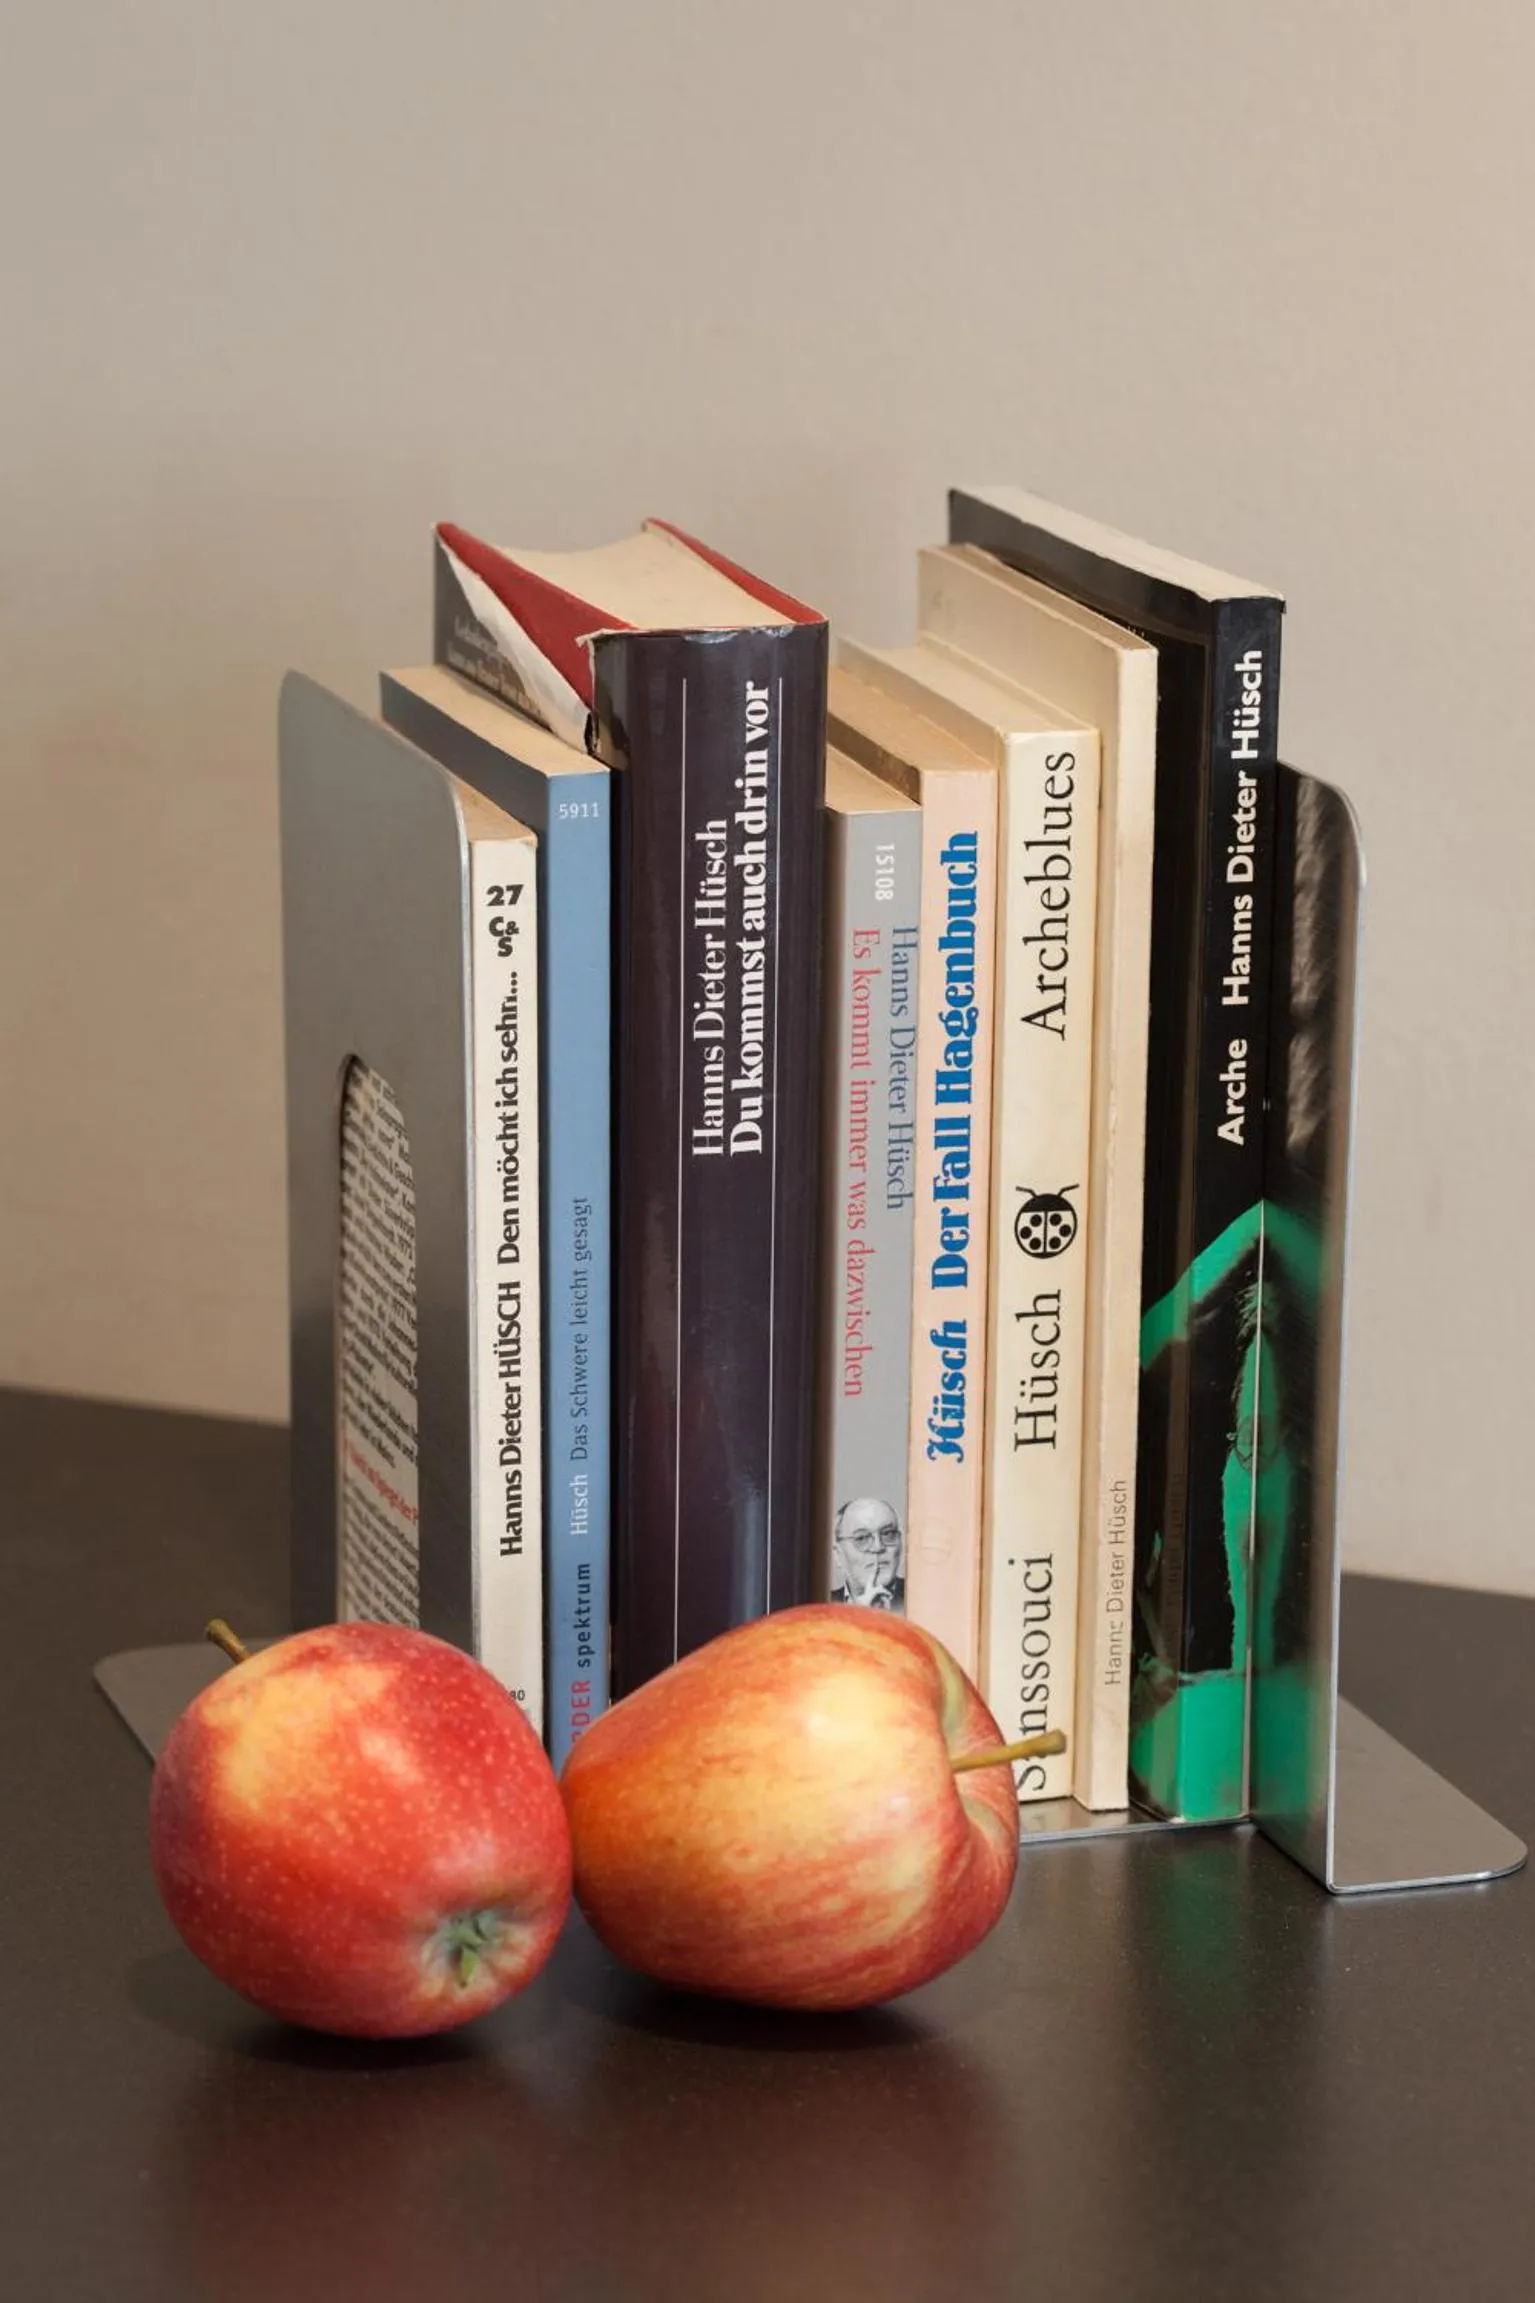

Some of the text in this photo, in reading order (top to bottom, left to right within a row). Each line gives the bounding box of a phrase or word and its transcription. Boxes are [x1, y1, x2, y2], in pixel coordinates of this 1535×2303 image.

[558, 803, 600, 818] 5911
[487, 884, 524, 906] 27
[875, 844, 894, 901] 15108
[1218, 651, 1262, 1145] Arche Hanns Dieter Hüsch
[730, 681, 769, 1156] Du kommst auch drin vor
[693, 820, 727, 1154] Hanns Dieter Hüsch
[495, 1067, 518, 1107] ich
[887, 927, 919, 1209] Hanns Dieter Hüsch
[496, 1112, 519, 1202] möcht
[845, 930, 882, 1396] Es kommt immer was dazwischen
[927, 831, 979, 1463] Hüsch Der Fall Hagenbuch
[497, 1208, 519, 1264] Den
[1007, 752, 1076, 1790] Snssouci Hüsch Archeblues
[493, 1282, 521, 1378] HÜSCH
[499, 1382, 521, 1466] Dieter
[500, 1470, 522, 1556] Hanns
[569, 1198, 595, 1742] DER spektrum Hüsch Das Schwere leicht gesagt
[1108, 1481, 1127, 1544] Hüsch
[1106, 1552, 1124, 1612] Dieter
